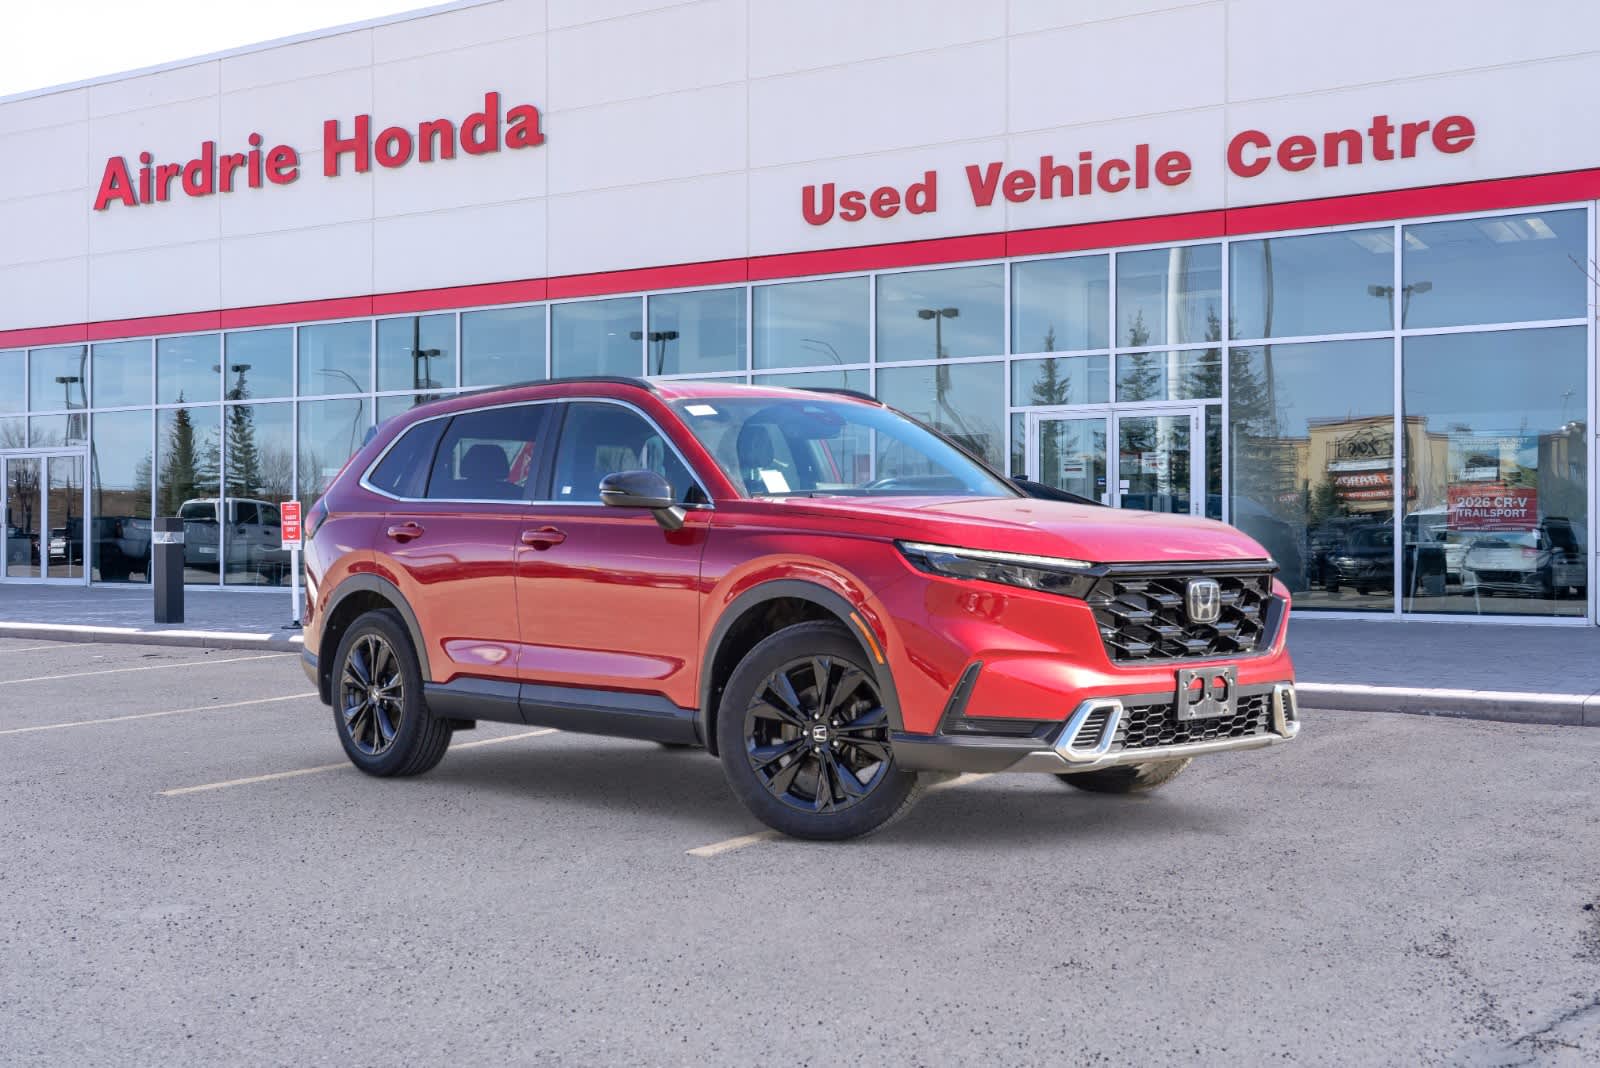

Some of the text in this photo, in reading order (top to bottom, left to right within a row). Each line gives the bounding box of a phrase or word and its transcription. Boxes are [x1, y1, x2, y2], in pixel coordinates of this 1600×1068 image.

[95, 91, 544, 210] Airdrie Honda
[802, 115, 1475, 226] Used Vehicle Centre
[1457, 497, 1527, 507] 2026 CR-V
[1458, 508, 1527, 517] TRAILSPORT
